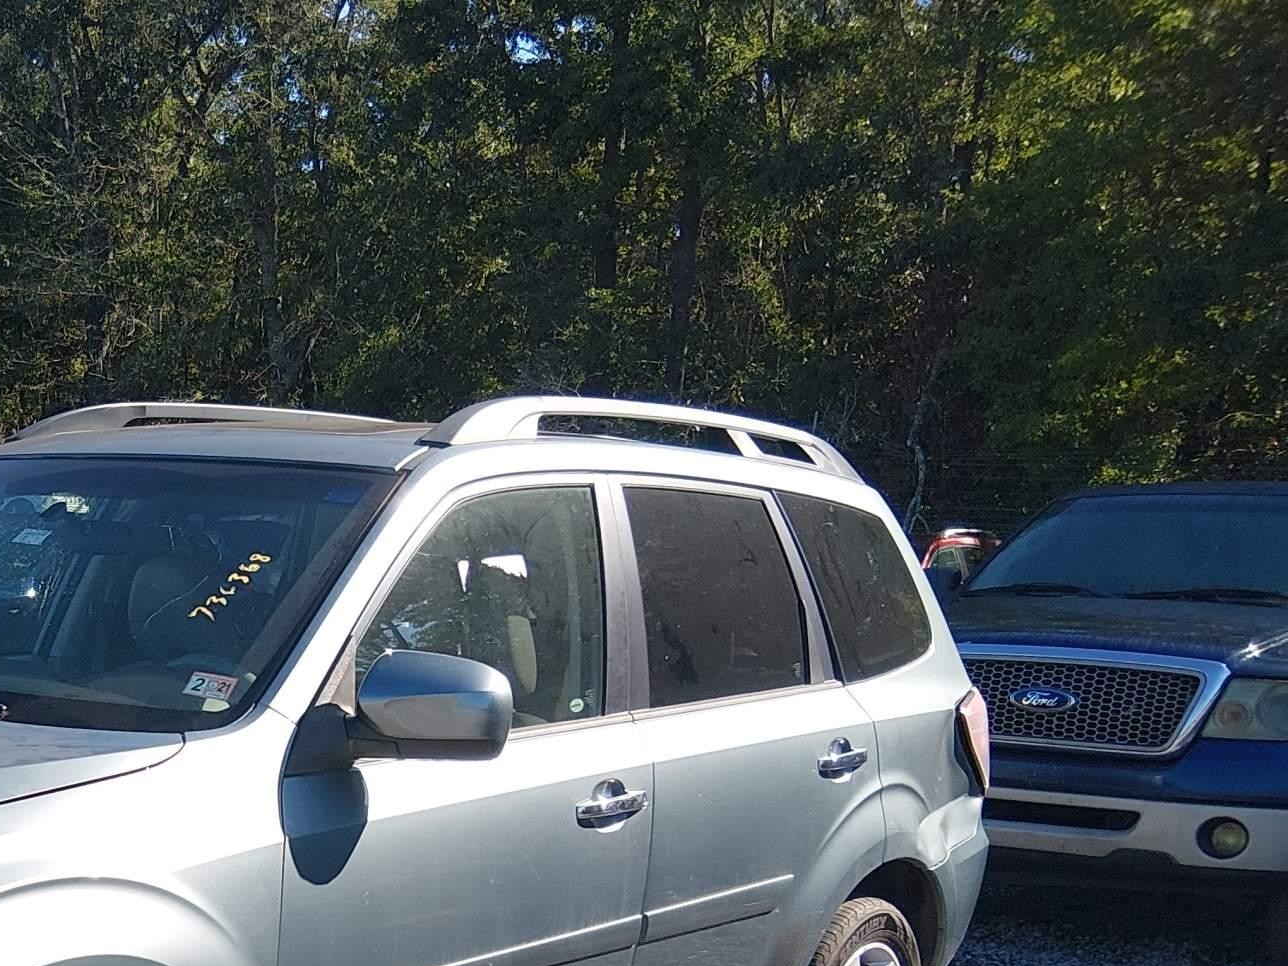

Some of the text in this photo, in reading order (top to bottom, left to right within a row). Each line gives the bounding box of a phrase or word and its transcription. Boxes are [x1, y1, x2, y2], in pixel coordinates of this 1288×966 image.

[190, 677, 206, 692] 2
[216, 681, 232, 695] 21
[1022, 690, 1059, 708] Ford
